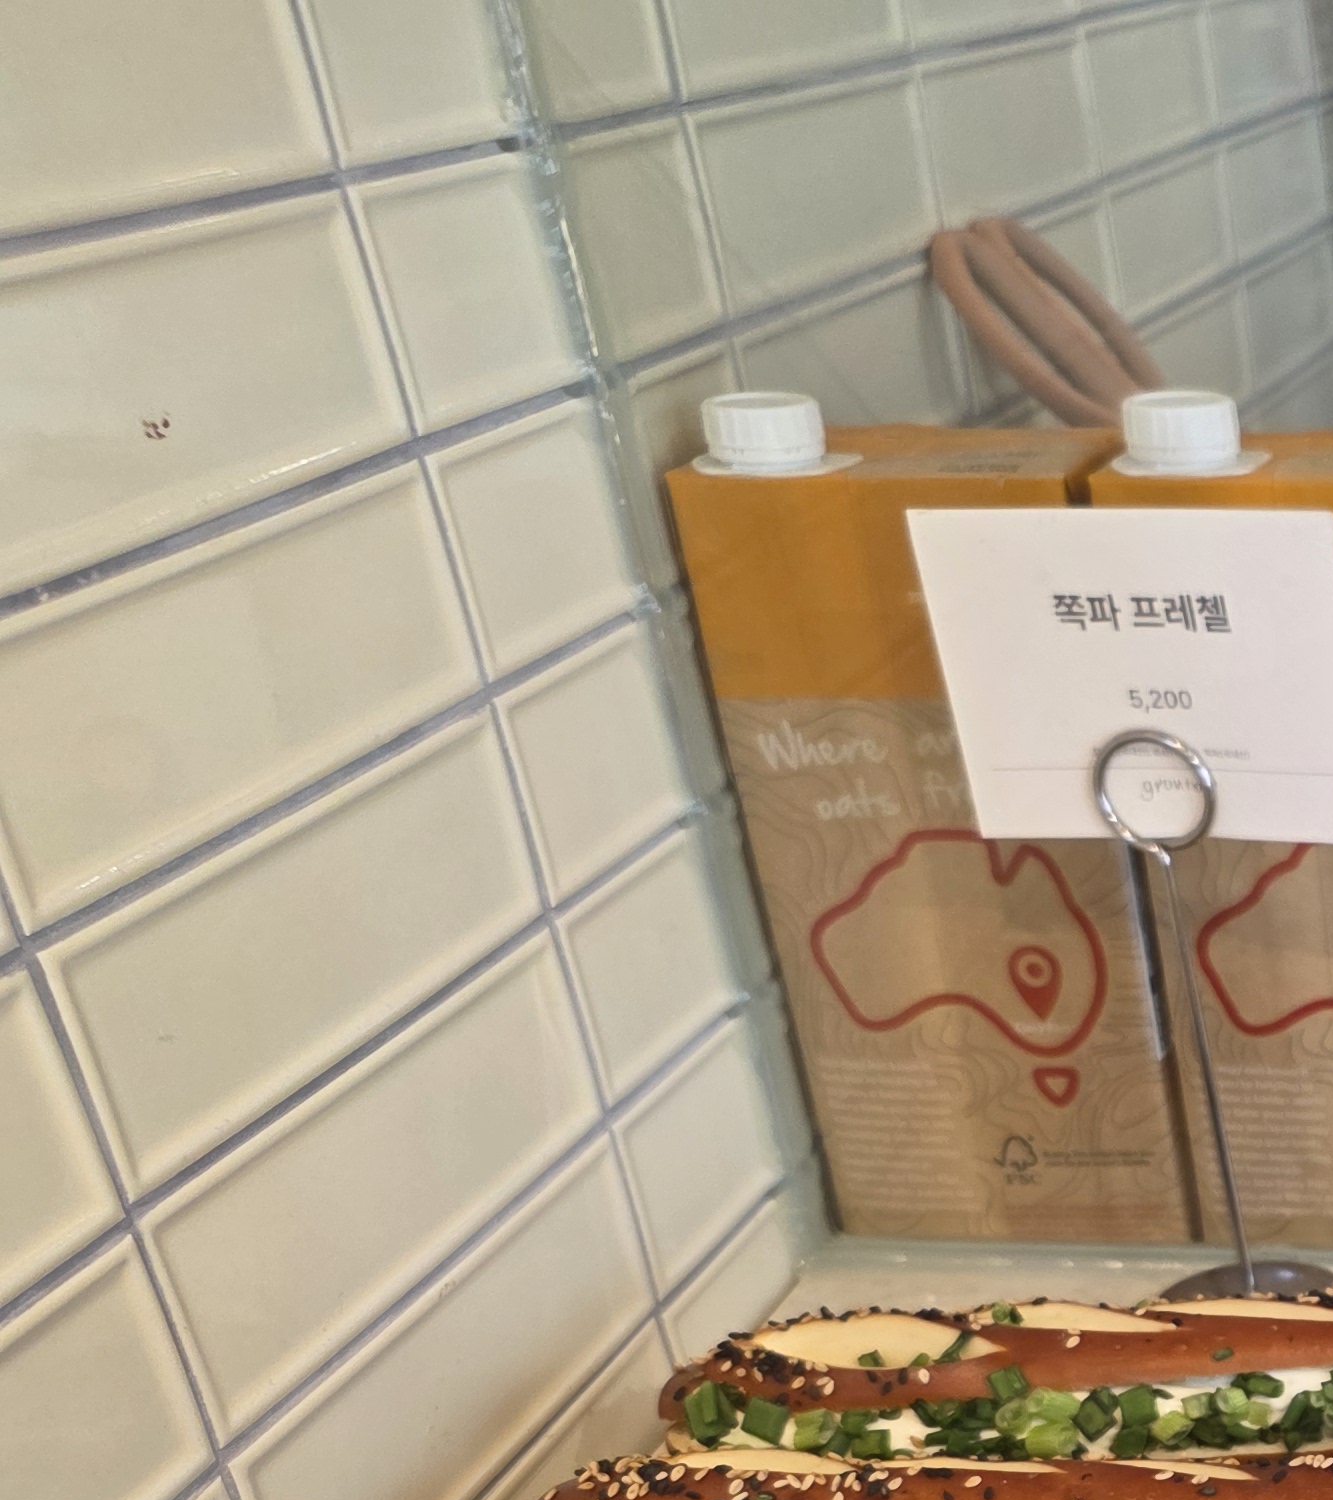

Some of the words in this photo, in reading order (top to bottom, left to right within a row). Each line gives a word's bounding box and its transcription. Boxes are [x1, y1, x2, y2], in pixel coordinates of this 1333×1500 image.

[1053, 594, 1121, 632] 쪽파
[1131, 594, 1232, 633] 프레첼
[1128, 688, 1193, 713] 5,200
[757, 719, 889, 771] Where
[815, 777, 901, 821] oats
